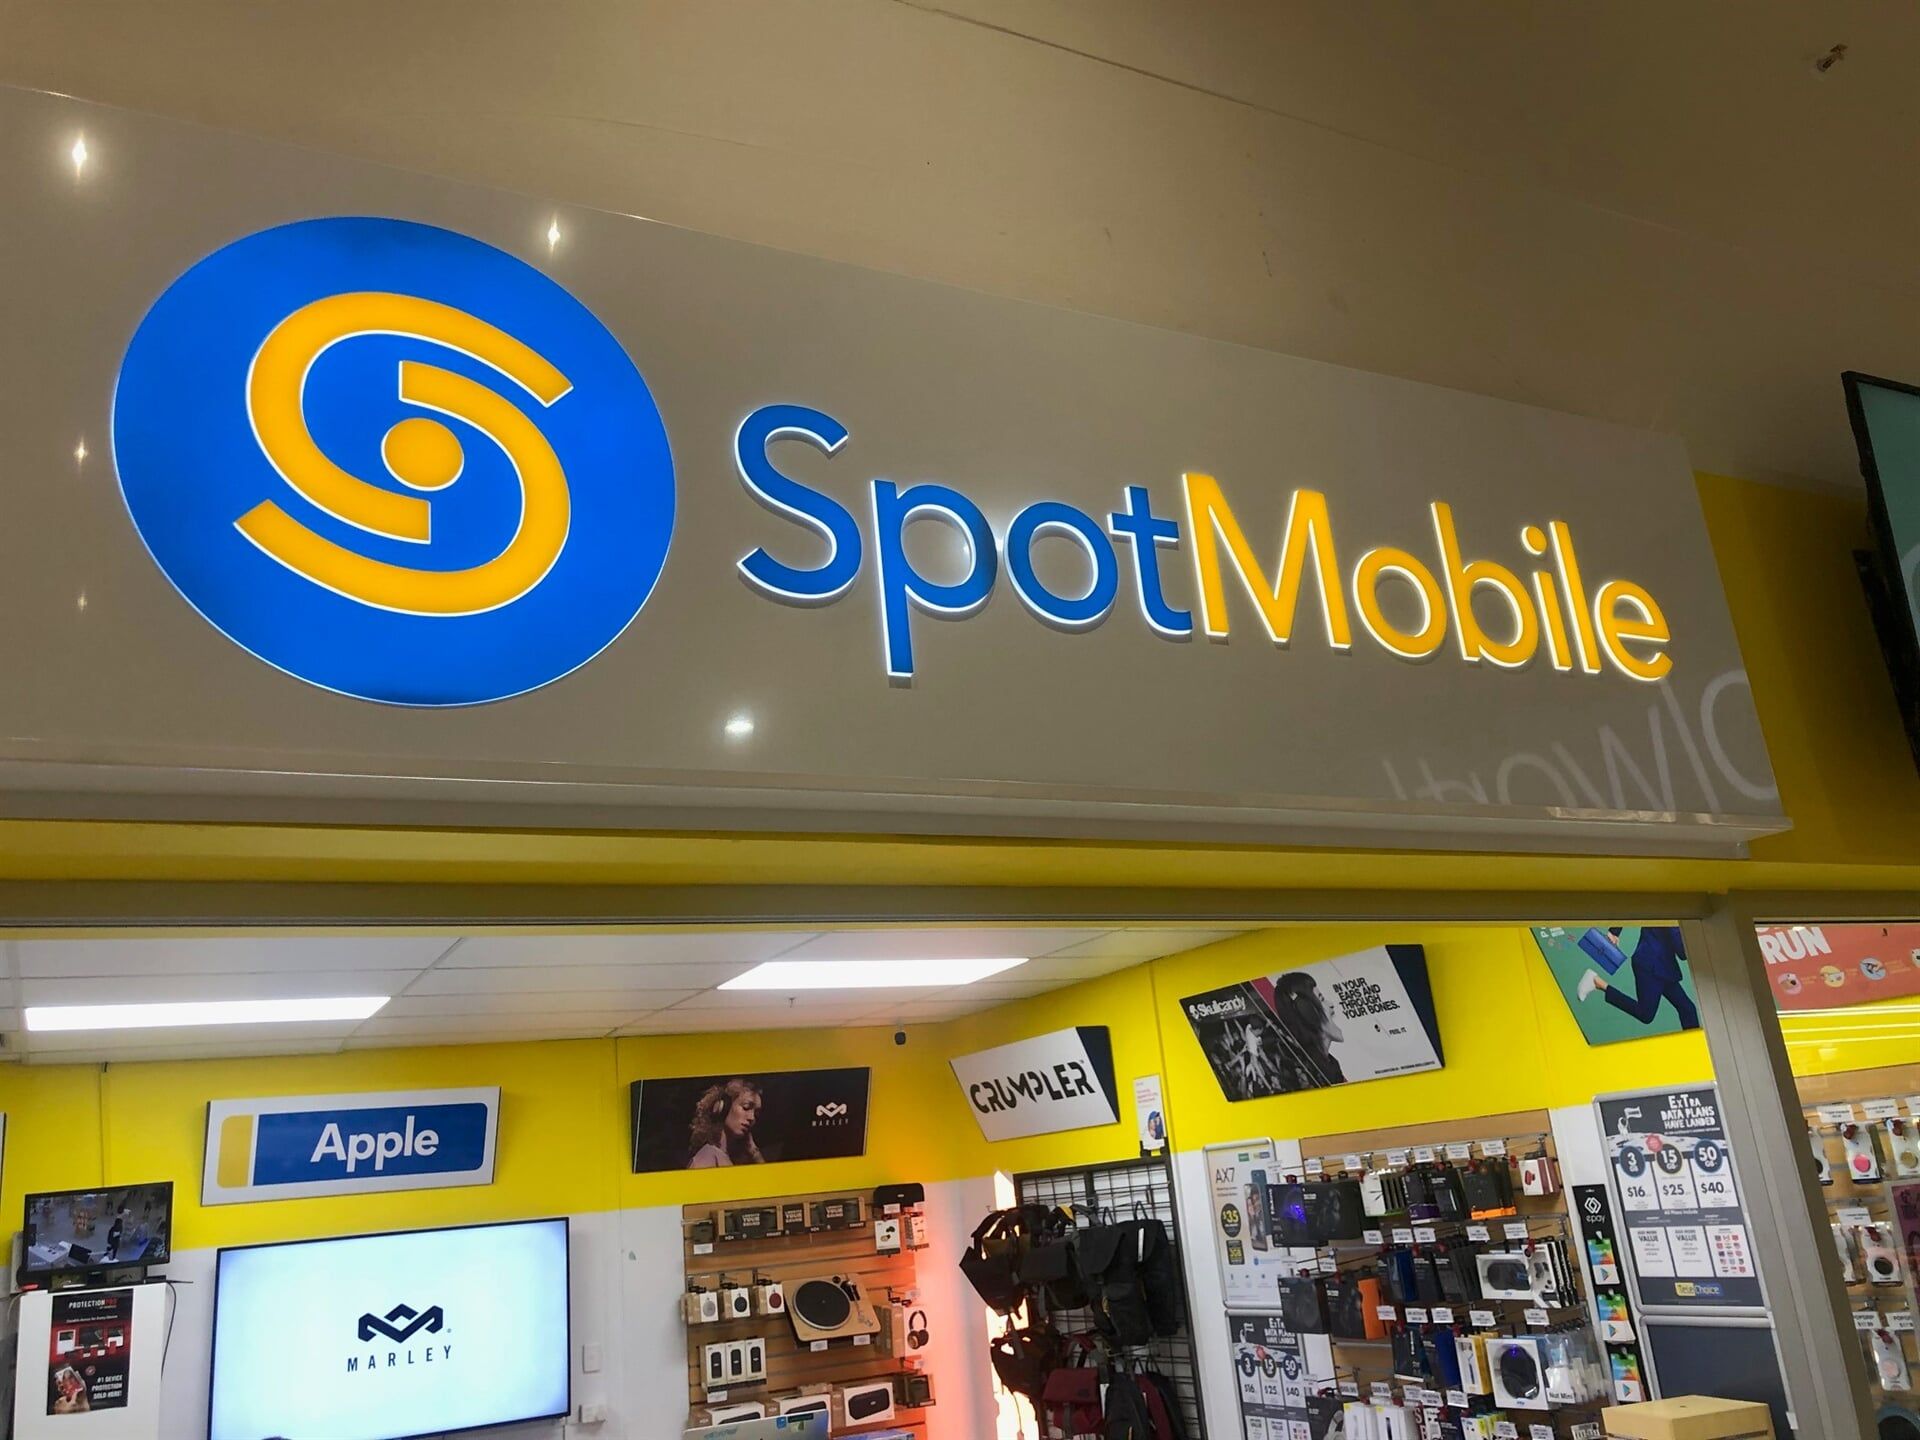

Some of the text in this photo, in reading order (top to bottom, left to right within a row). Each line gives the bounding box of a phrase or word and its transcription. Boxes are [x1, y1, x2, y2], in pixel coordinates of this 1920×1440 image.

[733, 403, 1674, 684] SpotMobile
[1758, 926, 1832, 964] RUN
[1332, 977, 1368, 993] IN YOUR
[1338, 984, 1381, 1001] EARS AND
[1197, 995, 1246, 1017] Skullcandy
[1339, 994, 1381, 1010] THROUGH
[1343, 1000, 1400, 1019] YOUR BONES.
[969, 1061, 1096, 1114] CRUMPLER
[1661, 1106, 1715, 1121] DATA PLANS
[1664, 1117, 1716, 1129] HAVE LANDED
[310, 1115, 440, 1173] Apple
[1627, 1146, 1718, 1165] 3 15 50
[1215, 1167, 1236, 1183] AX7
[1627, 1181, 1725, 1198] $16 $25 $40
[1222, 1210, 1240, 1224] $35
[1585, 1214, 1606, 1224] epay
[347, 1345, 452, 1372] MARLEY
[1284, 1360, 1297, 1371] 50
